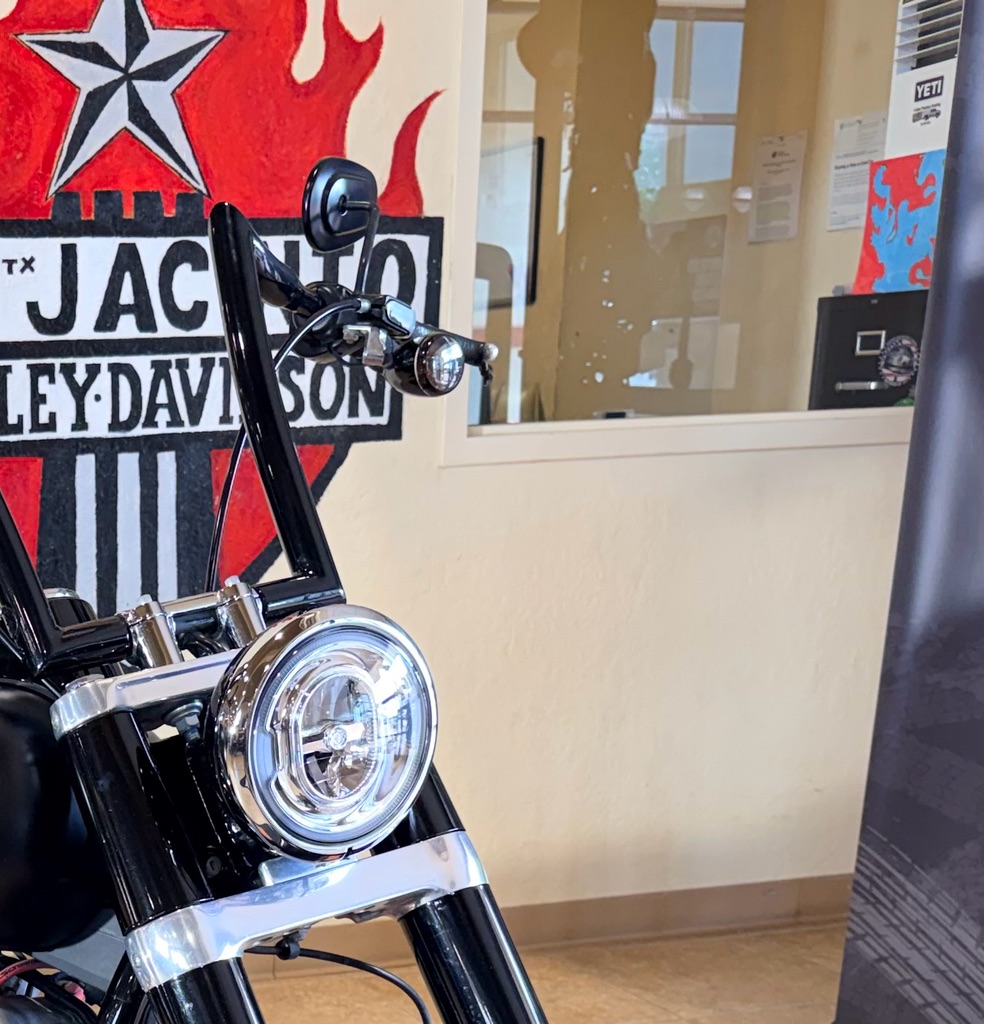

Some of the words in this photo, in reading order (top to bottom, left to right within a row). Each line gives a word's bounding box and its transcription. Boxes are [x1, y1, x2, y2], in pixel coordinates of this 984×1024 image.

[916, 79, 942, 99] YETI
[2, 256, 36, 275] TX
[26, 238, 417, 335] JACO
